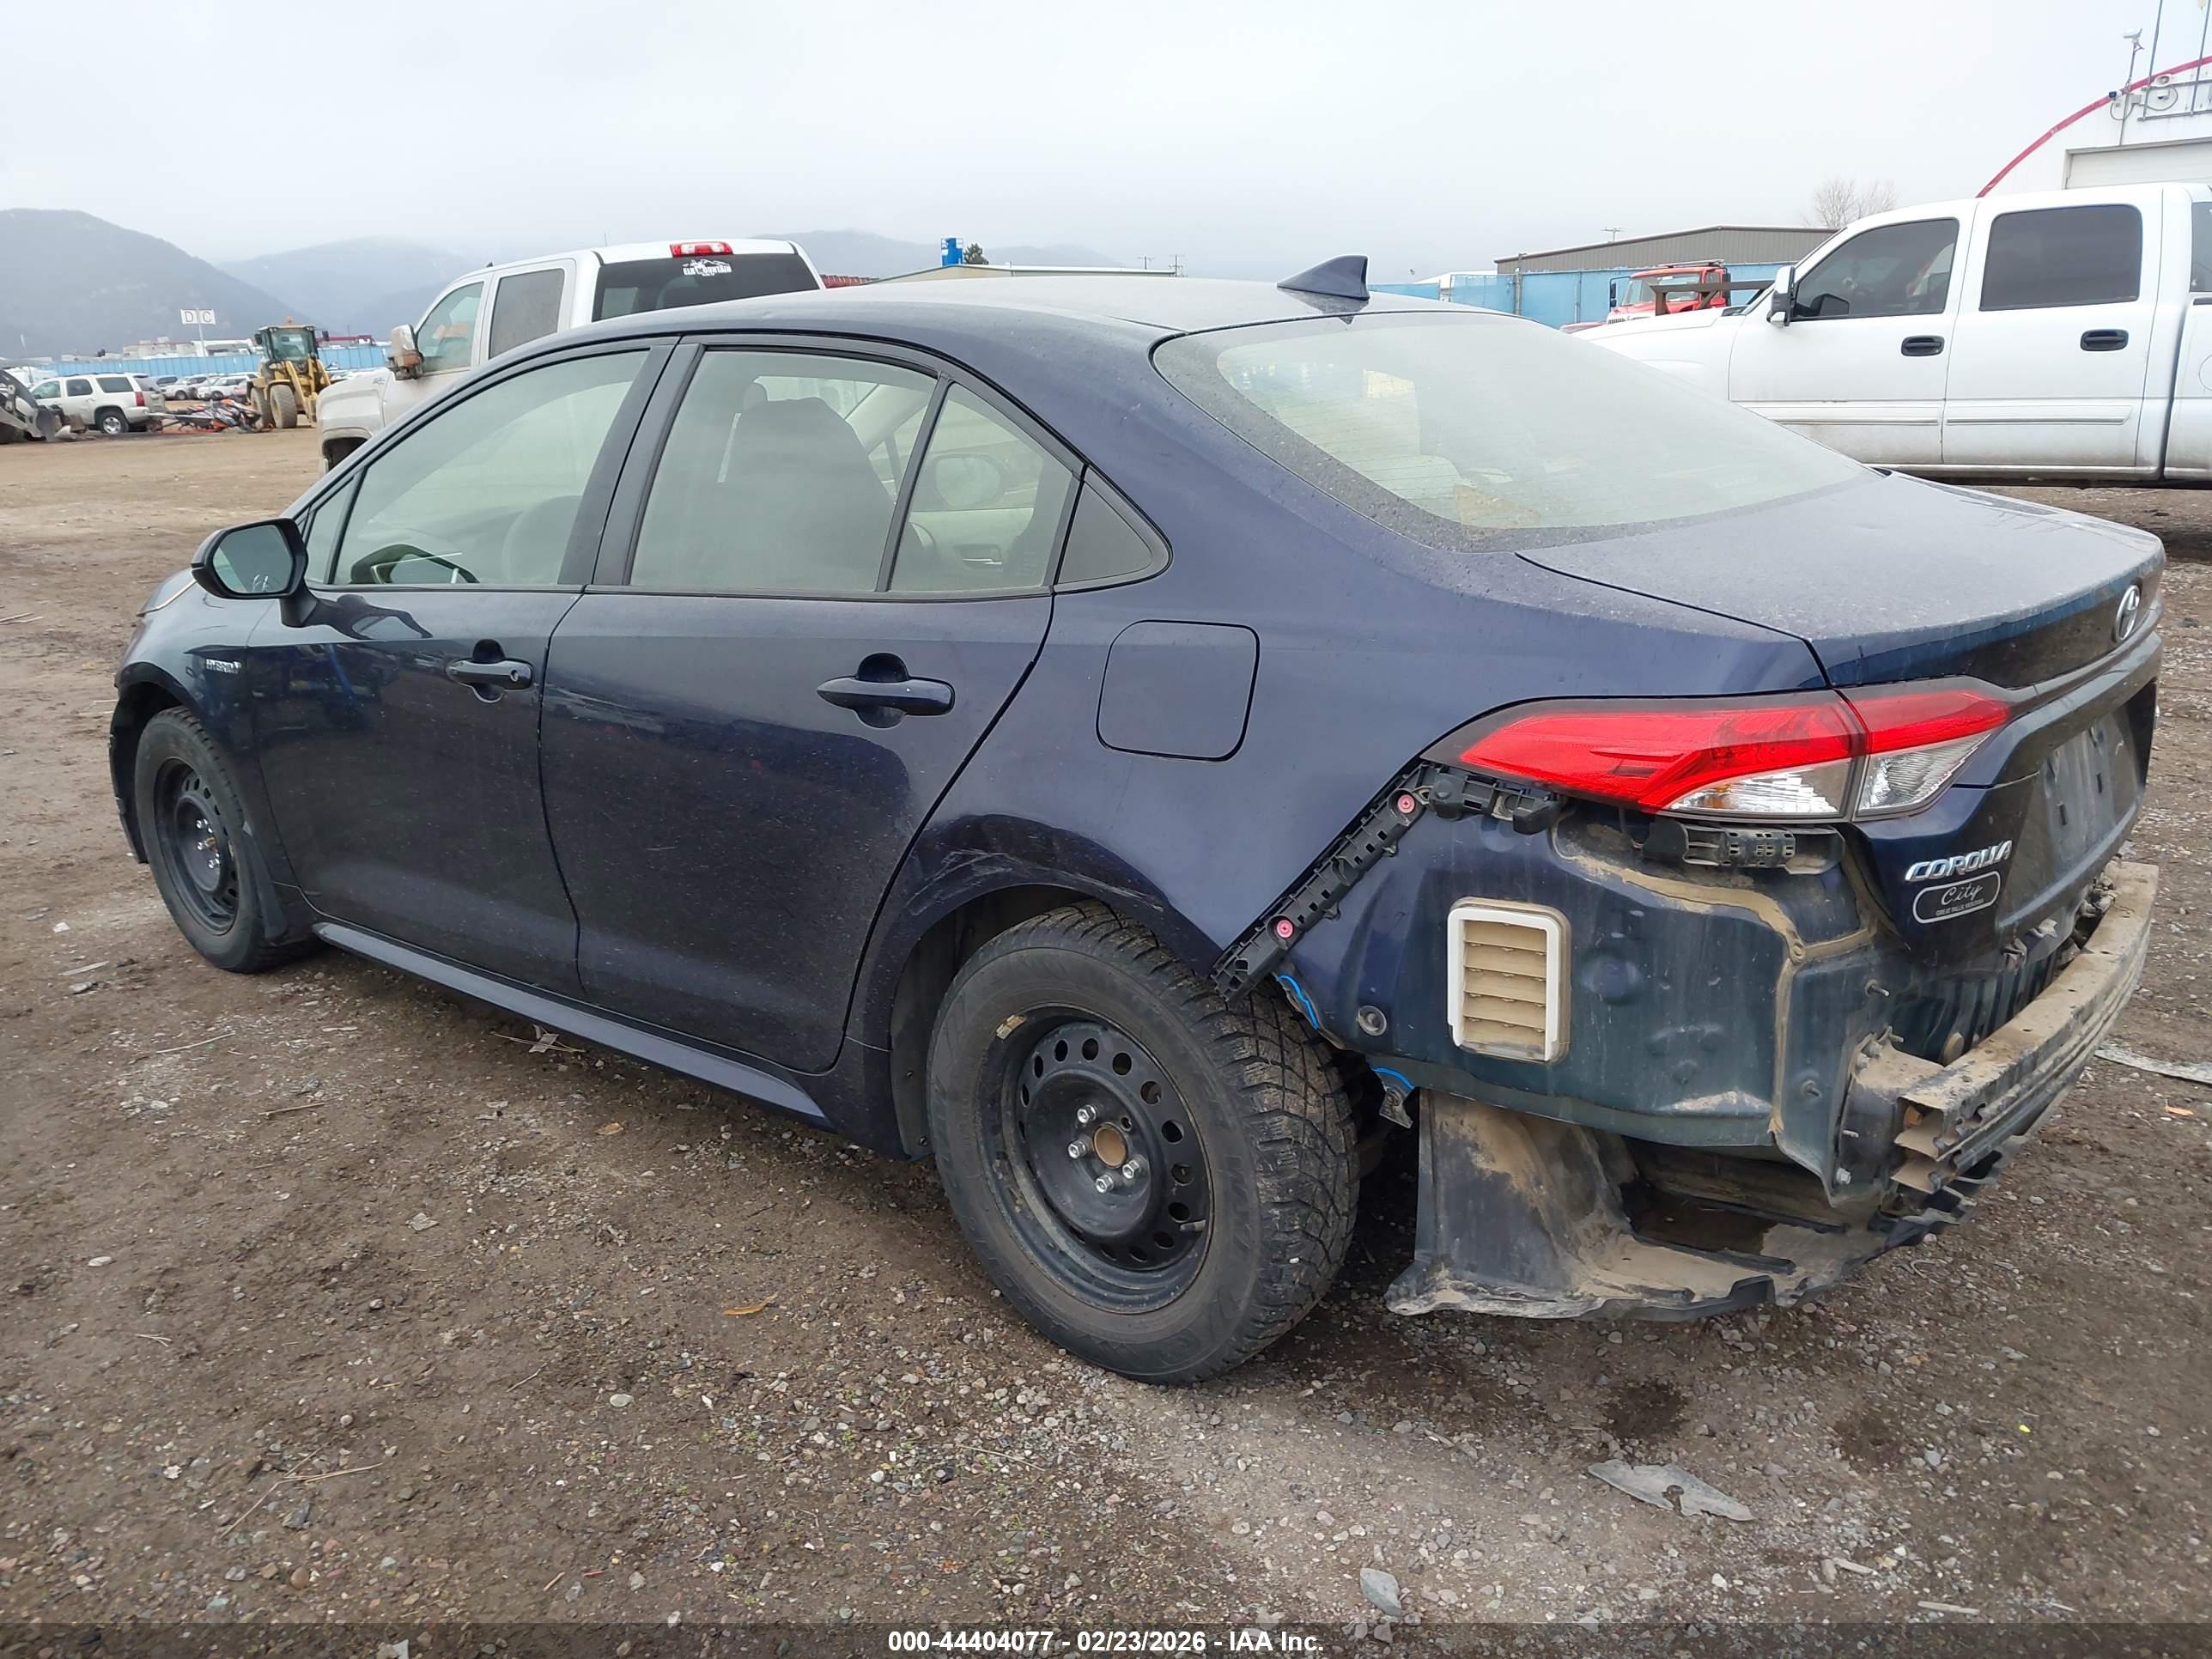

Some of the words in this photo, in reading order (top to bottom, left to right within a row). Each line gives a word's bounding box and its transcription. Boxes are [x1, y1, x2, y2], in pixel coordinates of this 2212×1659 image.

[185, 311, 193, 323] D
[1905, 840, 2013, 882] COROLLA
[1941, 882, 1983, 906] City
